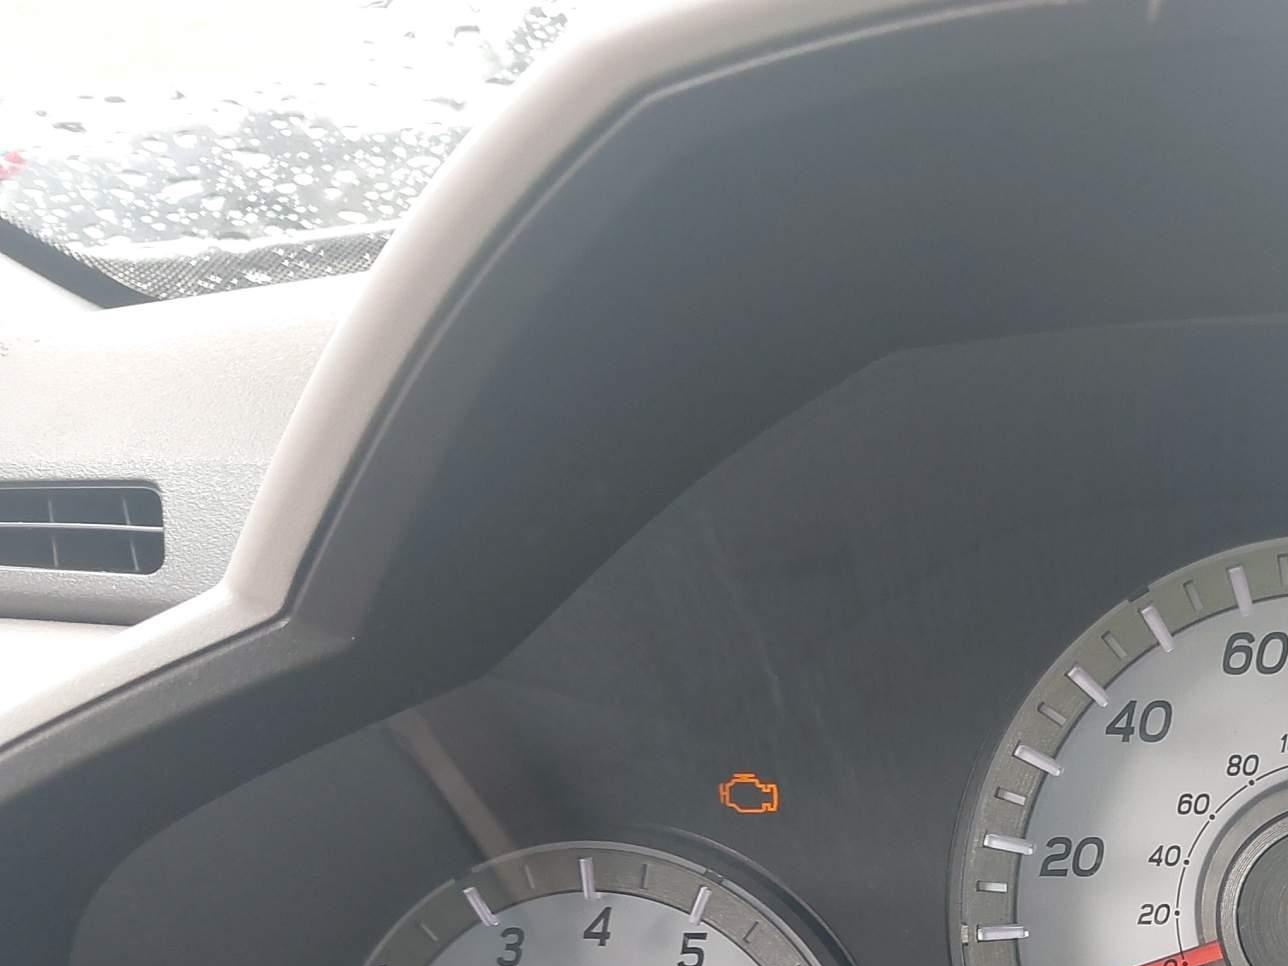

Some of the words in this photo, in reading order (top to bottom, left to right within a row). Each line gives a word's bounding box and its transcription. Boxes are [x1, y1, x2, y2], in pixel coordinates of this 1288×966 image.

[1222, 631, 1288, 674] 60
[1106, 701, 1172, 743] 40
[1226, 755, 1259, 776] 80
[1177, 794, 1210, 815] 60
[1040, 837, 1103, 877] 20
[1149, 845, 1181, 866] 40
[584, 908, 613, 946] 4
[1137, 904, 1170, 925] 20
[498, 928, 524, 966] 3
